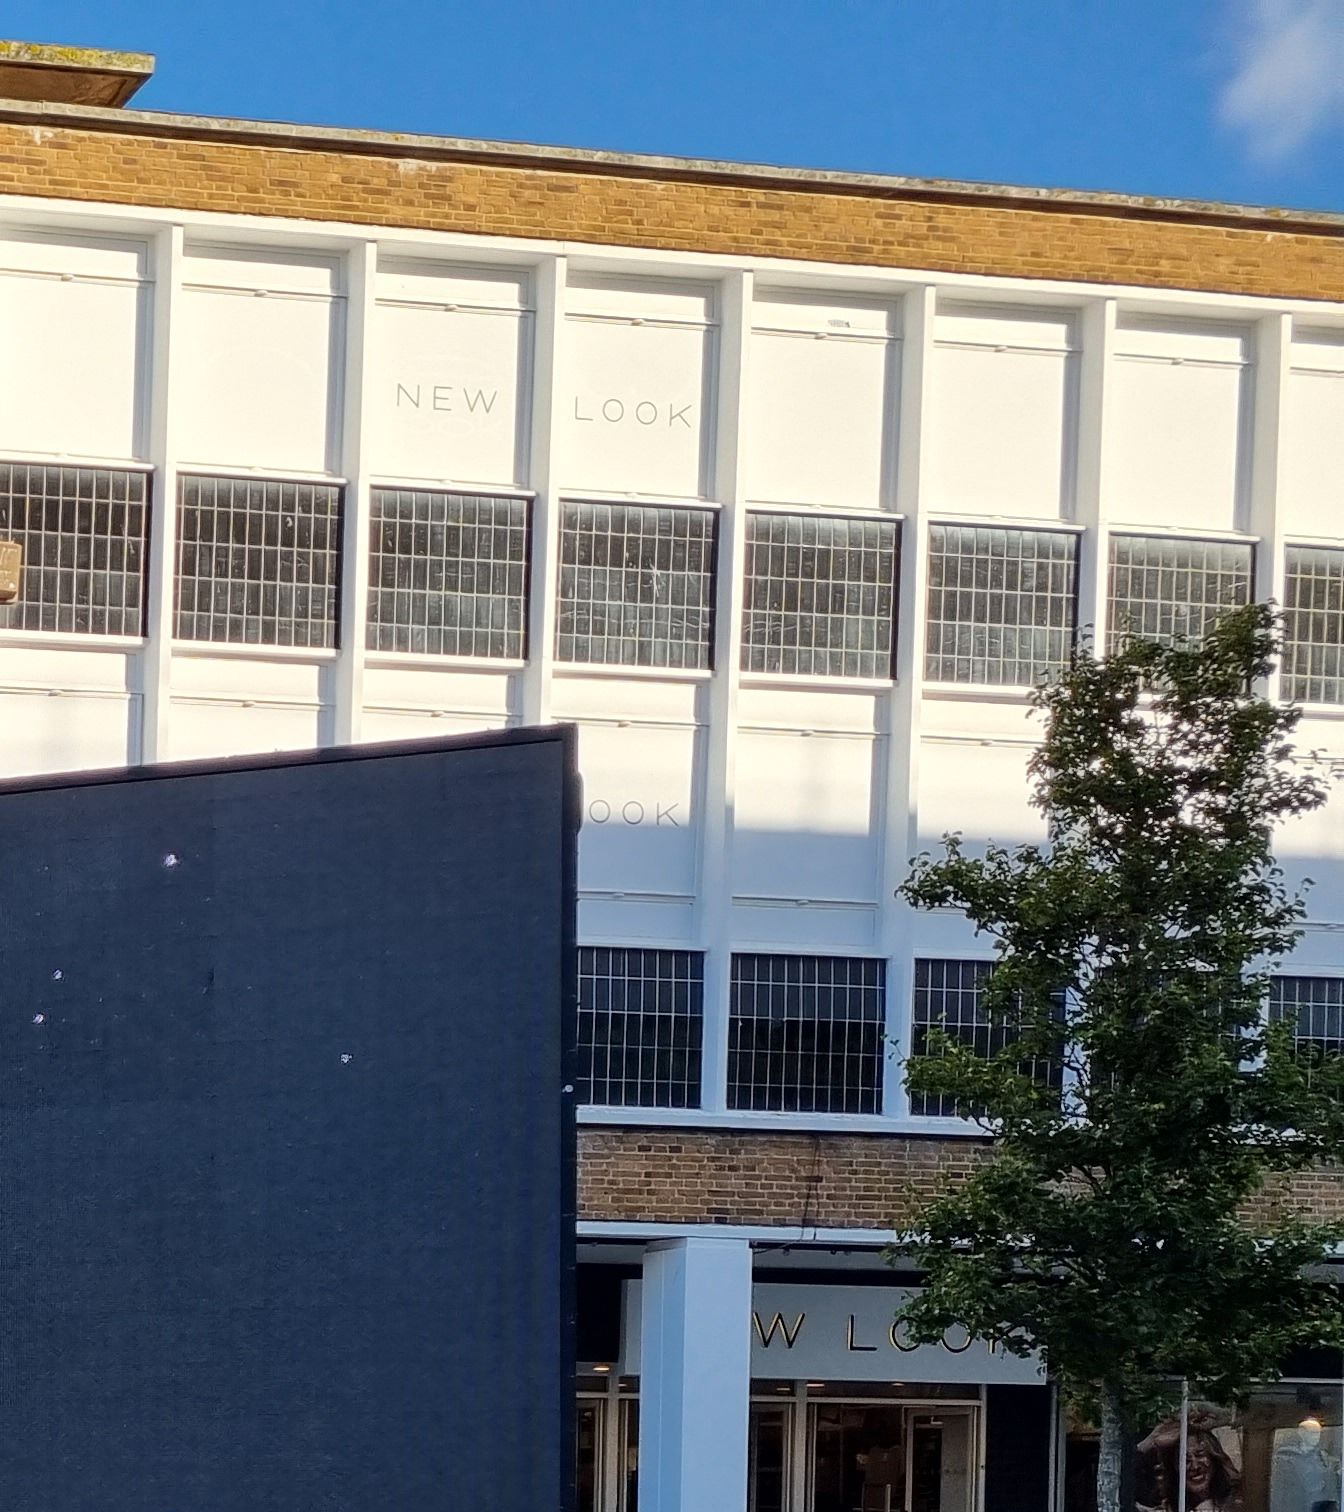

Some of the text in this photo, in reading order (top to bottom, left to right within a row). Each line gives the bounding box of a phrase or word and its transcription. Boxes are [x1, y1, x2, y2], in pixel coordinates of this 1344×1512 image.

[396, 382, 693, 428] NEW LOOK
[588, 799, 680, 828] OOK
[846, 1313, 1002, 1354] LOO
